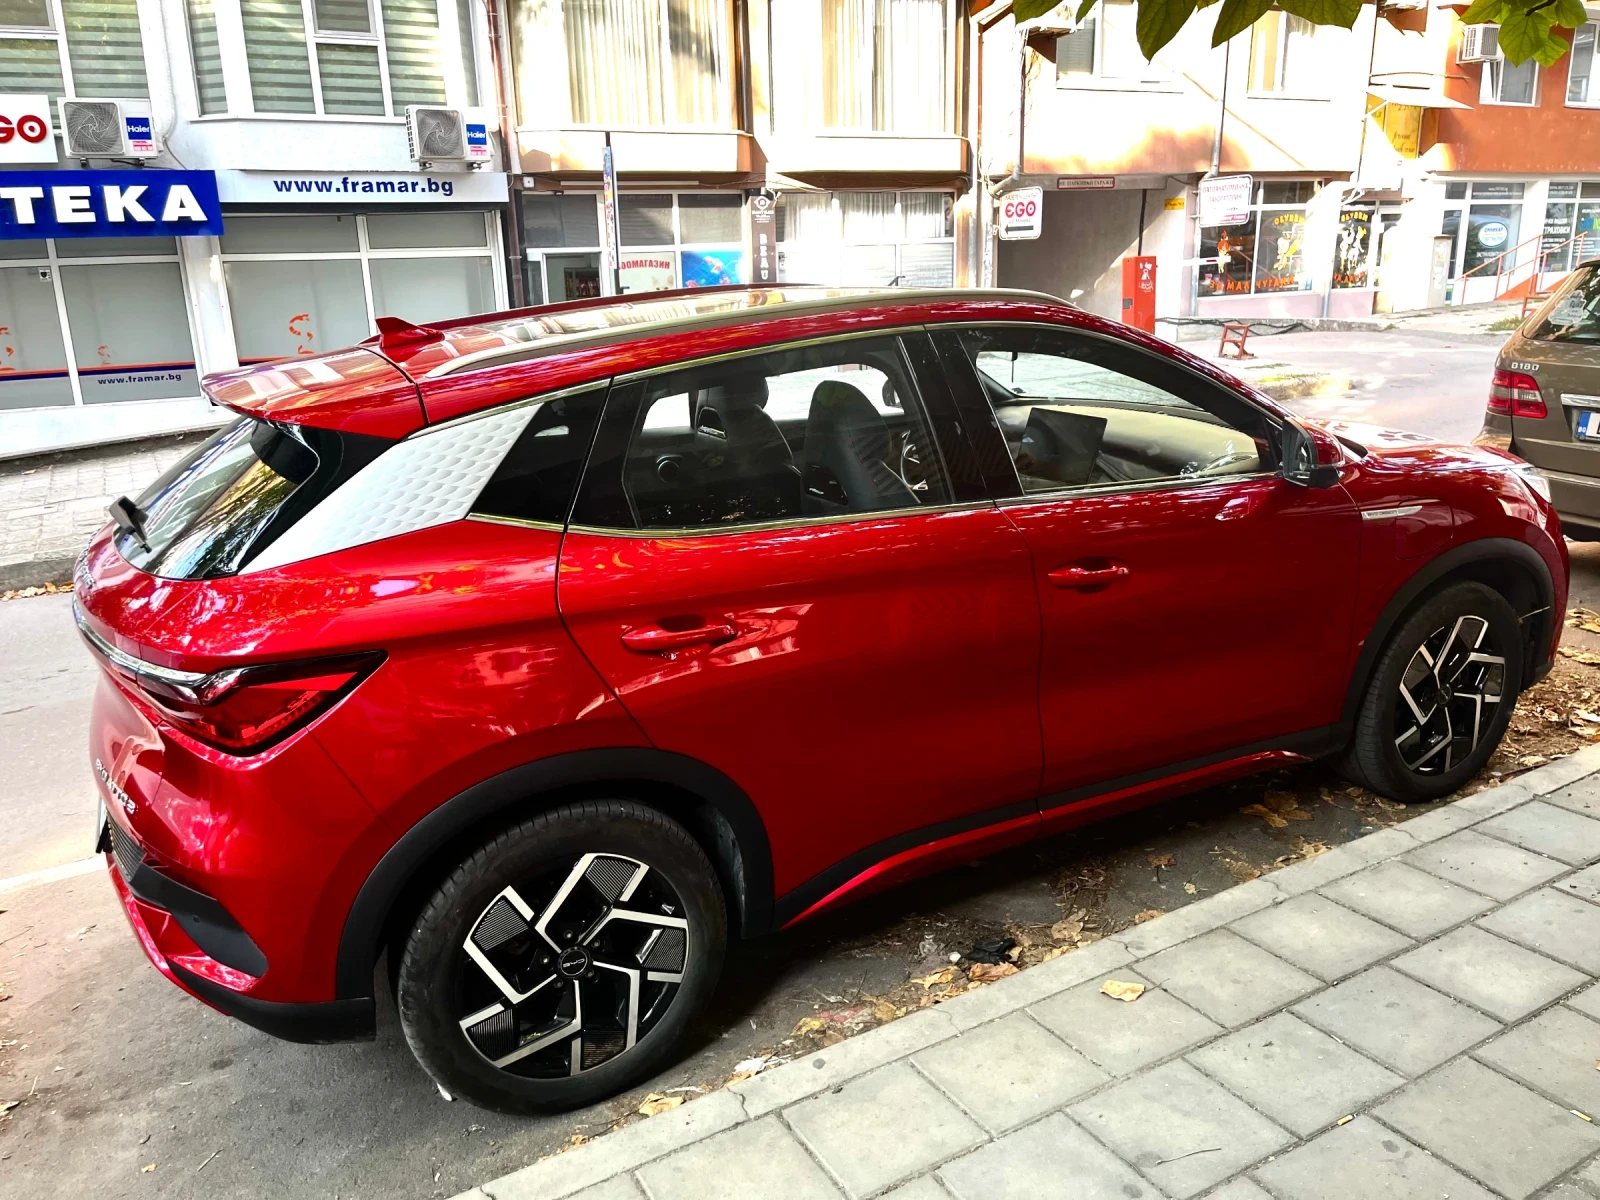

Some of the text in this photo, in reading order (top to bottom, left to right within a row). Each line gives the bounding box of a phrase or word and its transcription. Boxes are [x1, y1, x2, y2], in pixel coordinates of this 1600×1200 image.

[127, 125, 150, 133] Haier
[467, 131, 486, 139] Haier
[273, 177, 454, 197] www.framar.bg
[0, 185, 208, 225] ТЕКА
[1005, 200, 1036, 218] EGO
[619, 259, 671, 270] ООМАГАЗИН
[98, 373, 182, 385] www.framar.bg
